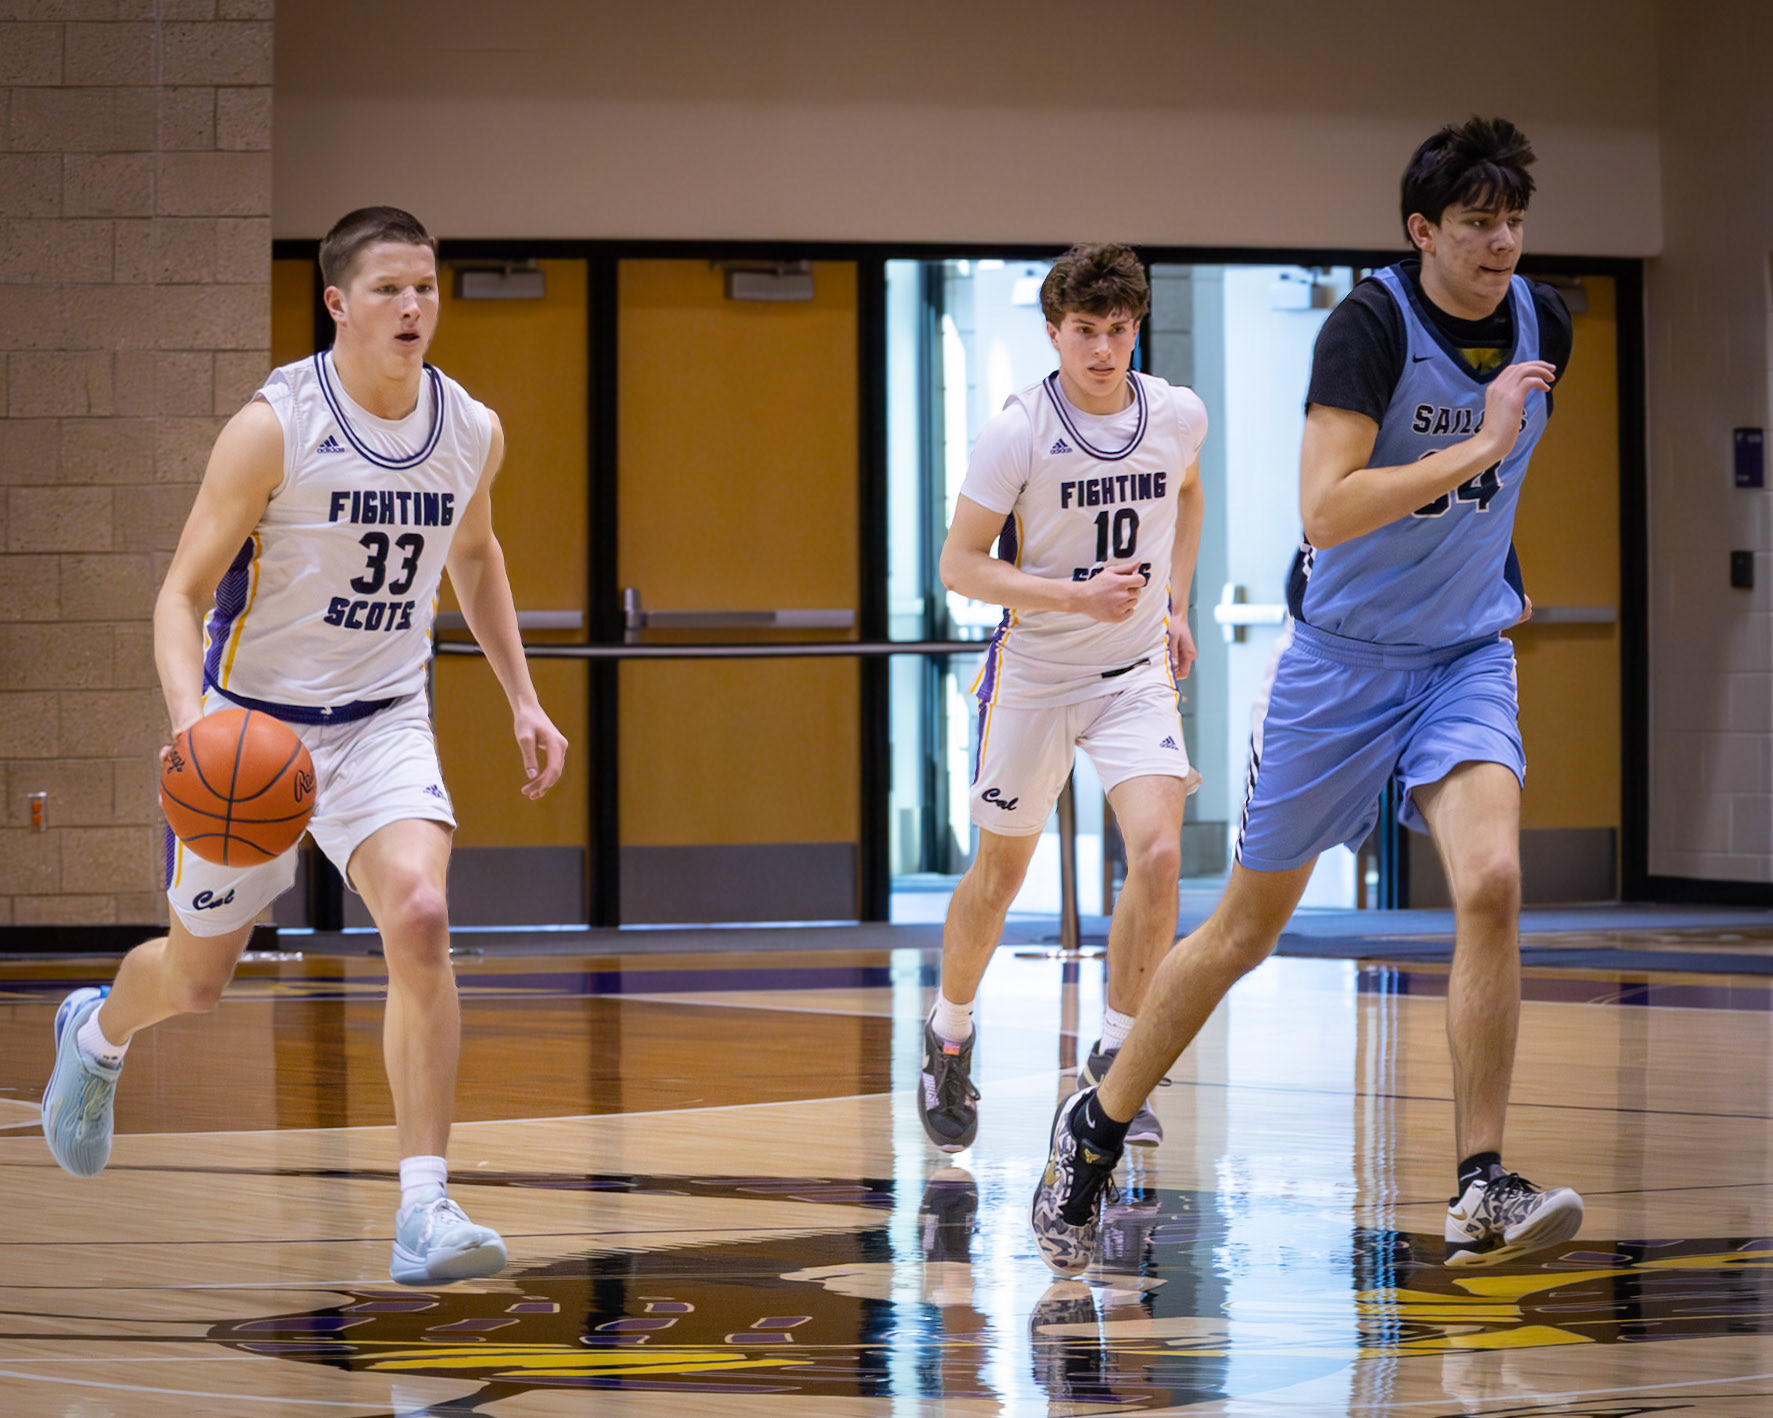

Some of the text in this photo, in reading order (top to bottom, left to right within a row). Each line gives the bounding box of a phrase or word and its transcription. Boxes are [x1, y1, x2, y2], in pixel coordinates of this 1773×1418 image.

[1411, 403, 1529, 436] SAIL
[328, 490, 455, 526] FIGHTING
[1060, 472, 1167, 509] FIGHTING
[1094, 508, 1140, 563] 10
[350, 531, 425, 596] 33
[323, 596, 416, 632] SCOTS
[981, 787, 1020, 812] Cal
